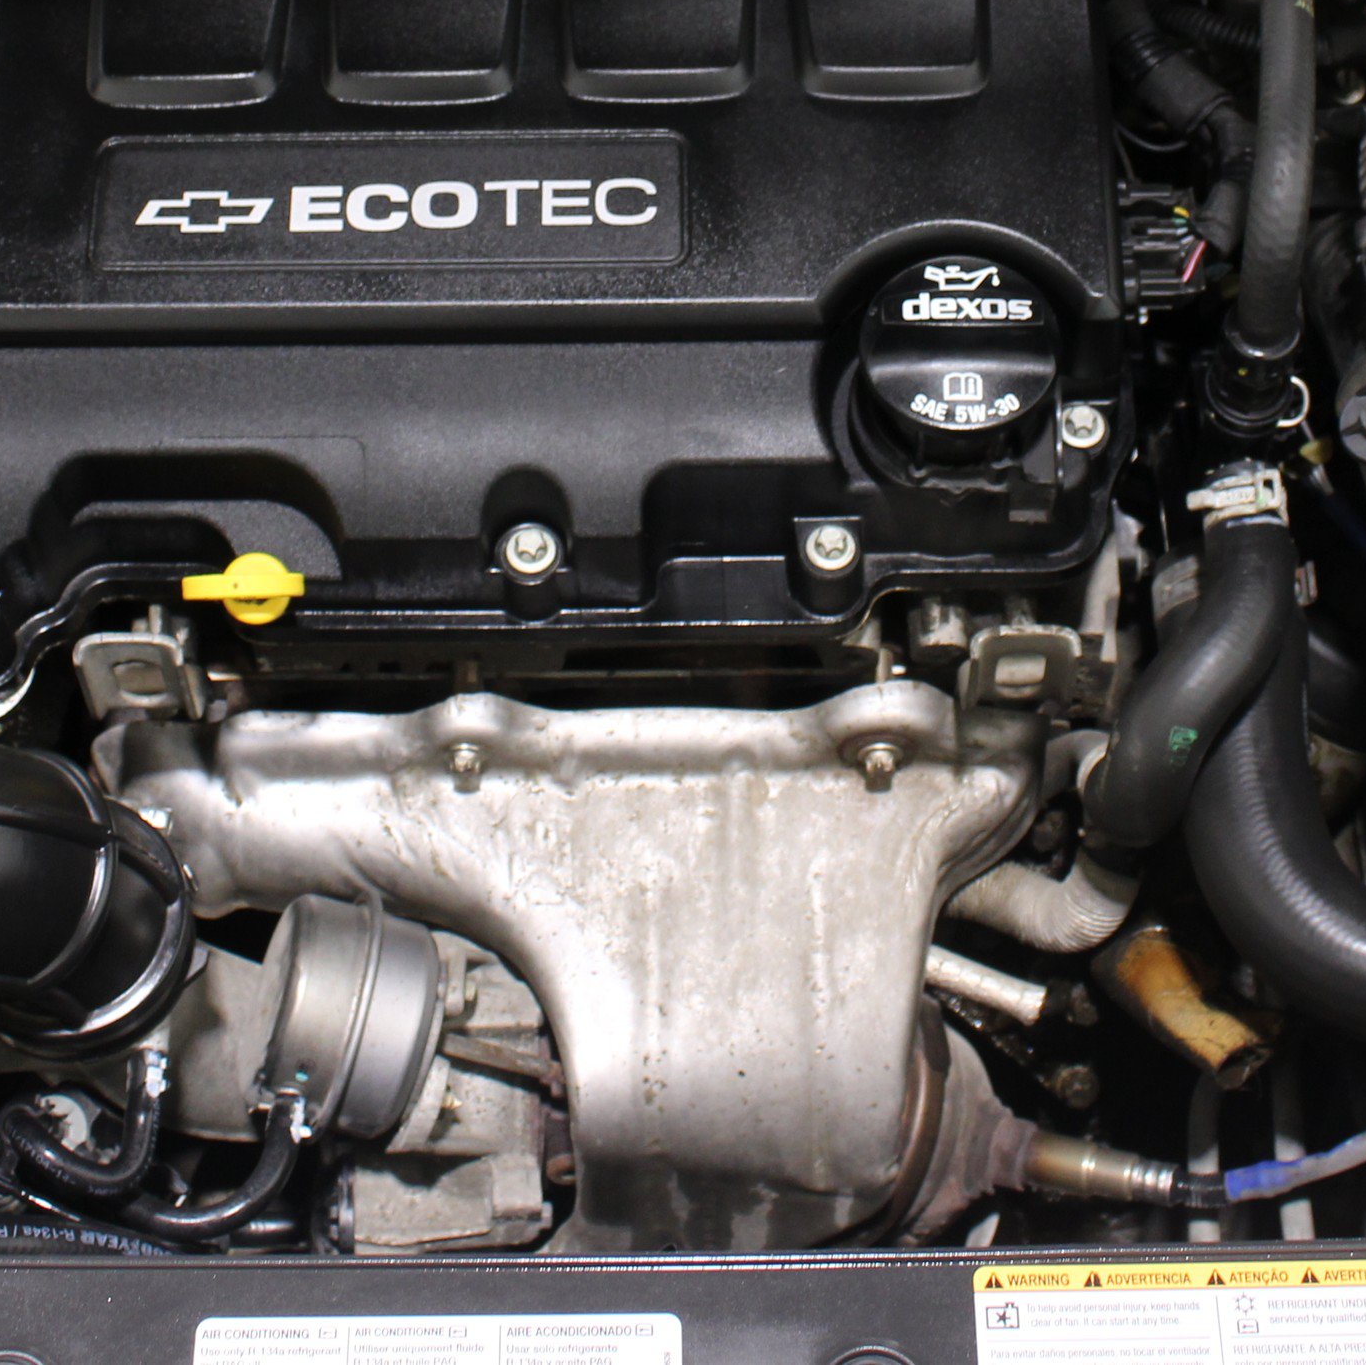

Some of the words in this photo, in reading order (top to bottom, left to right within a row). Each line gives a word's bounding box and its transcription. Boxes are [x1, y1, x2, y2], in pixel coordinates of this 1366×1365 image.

[288, 177, 657, 232] ECOTEC
[901, 292, 1033, 321] dexos
[910, 393, 948, 422] SAE
[954, 393, 1021, 423] 5W-30
[1008, 1272, 1070, 1287] WARNING
[1106, 1271, 1192, 1286] ADVERTENCIA
[1229, 1268, 1288, 1286] ATENÇÃO
[1038, 1304, 1056, 1315] help
[1058, 1303, 1082, 1312] avoid
[1083, 1302, 1121, 1314] personal
[1150, 1302, 1172, 1313] keep
[1173, 1301, 1200, 1311] hands
[1268, 1298, 1339, 1311] REFRIGERANT
[1030, 1317, 1052, 1327] clear
[1054, 1317, 1063, 1327] of
[1091, 1317, 1107, 1326] can
[1109, 1316, 1129, 1326] start
[1131, 1317, 1140, 1325] at
[1142, 1317, 1158, 1327] any
[1269, 1313, 1309, 1325] serviced
[1311, 1312, 1324, 1326] by
[1326, 1311, 1366, 1325] qualified
[201, 1329, 221, 1340] AIR
[224, 1328, 310, 1340] CONDITIONING
[354, 1327, 372, 1337] AIR
[506, 1326, 532, 1337] AIRE
[535, 1325, 632, 1337] ACONDICIONADO
[200, 1347, 220, 1356] Use
[223, 1346, 245, 1358] only
[287, 1346, 341, 1358] refrigerant
[353, 1343, 389, 1353] Utiliser
[392, 1343, 453, 1355] uniquement
[456, 1343, 485, 1353] fluide
[506, 1344, 530, 1353] Usar
[533, 1343, 555, 1353] solo
[557, 1343, 619, 1355] refrigerante
[990, 1349, 1010, 1358] Para
[1012, 1348, 1036, 1358] evitar
[1039, 1347, 1066, 1358] daños
[1119, 1348, 1131, 1357] no
[1133, 1347, 1155, 1356] tocar
[1157, 1346, 1166, 1356] el
[1168, 1346, 1211, 1356] ventilador
[1233, 1344, 1306, 1355] REFRIGERANTE
[1309, 1343, 1316, 1353] A
[1318, 1343, 1342, 1353] ALTA
